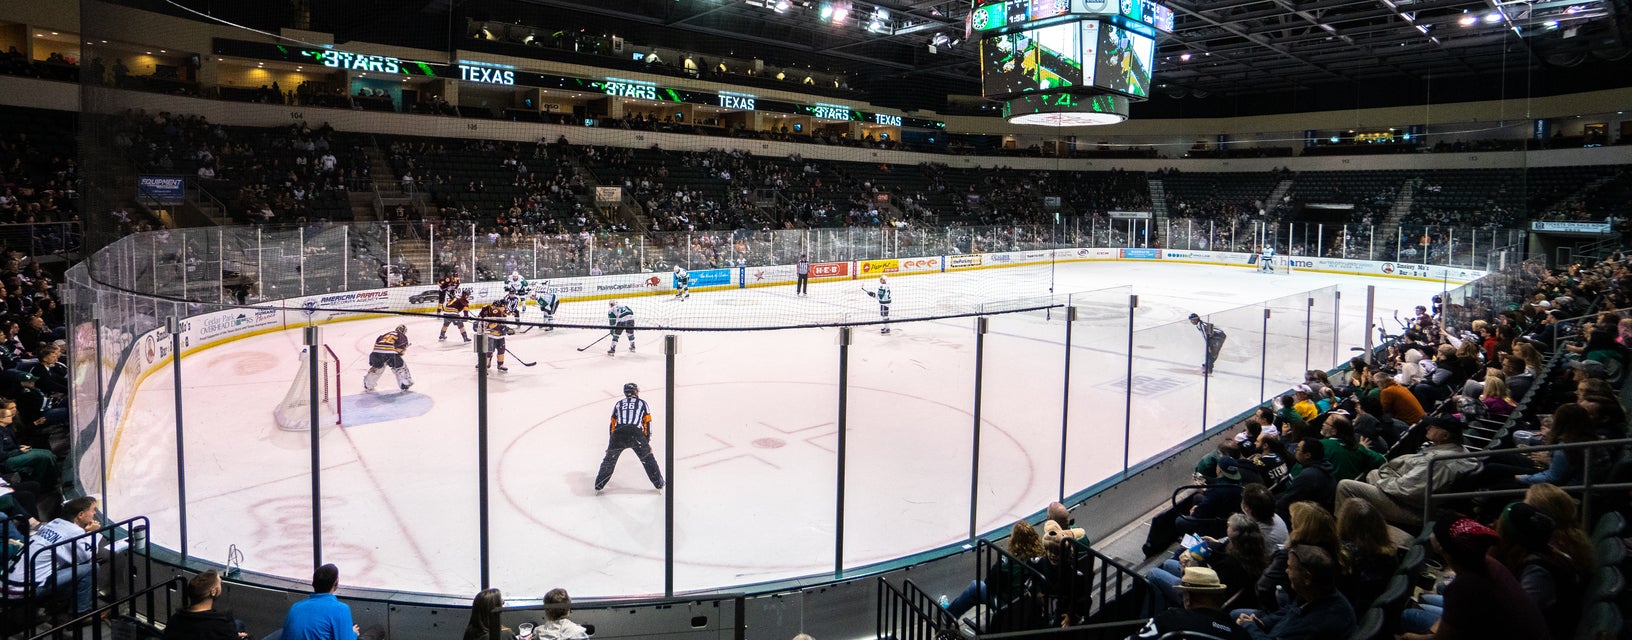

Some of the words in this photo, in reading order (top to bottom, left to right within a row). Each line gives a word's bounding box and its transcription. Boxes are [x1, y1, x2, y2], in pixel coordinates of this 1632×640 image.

[458, 65, 514, 85] TEXAS
[718, 95, 755, 110] TEXAS
[875, 113, 902, 126] TEXAS
[320, 294, 356, 303] AMERICAN
[356, 291, 388, 299] PARATUS
[203, 316, 221, 326] Cedar
[222, 313, 234, 322] Park
[200, 321, 231, 335] OVERHEAD
[622, 402, 635, 410] 26
